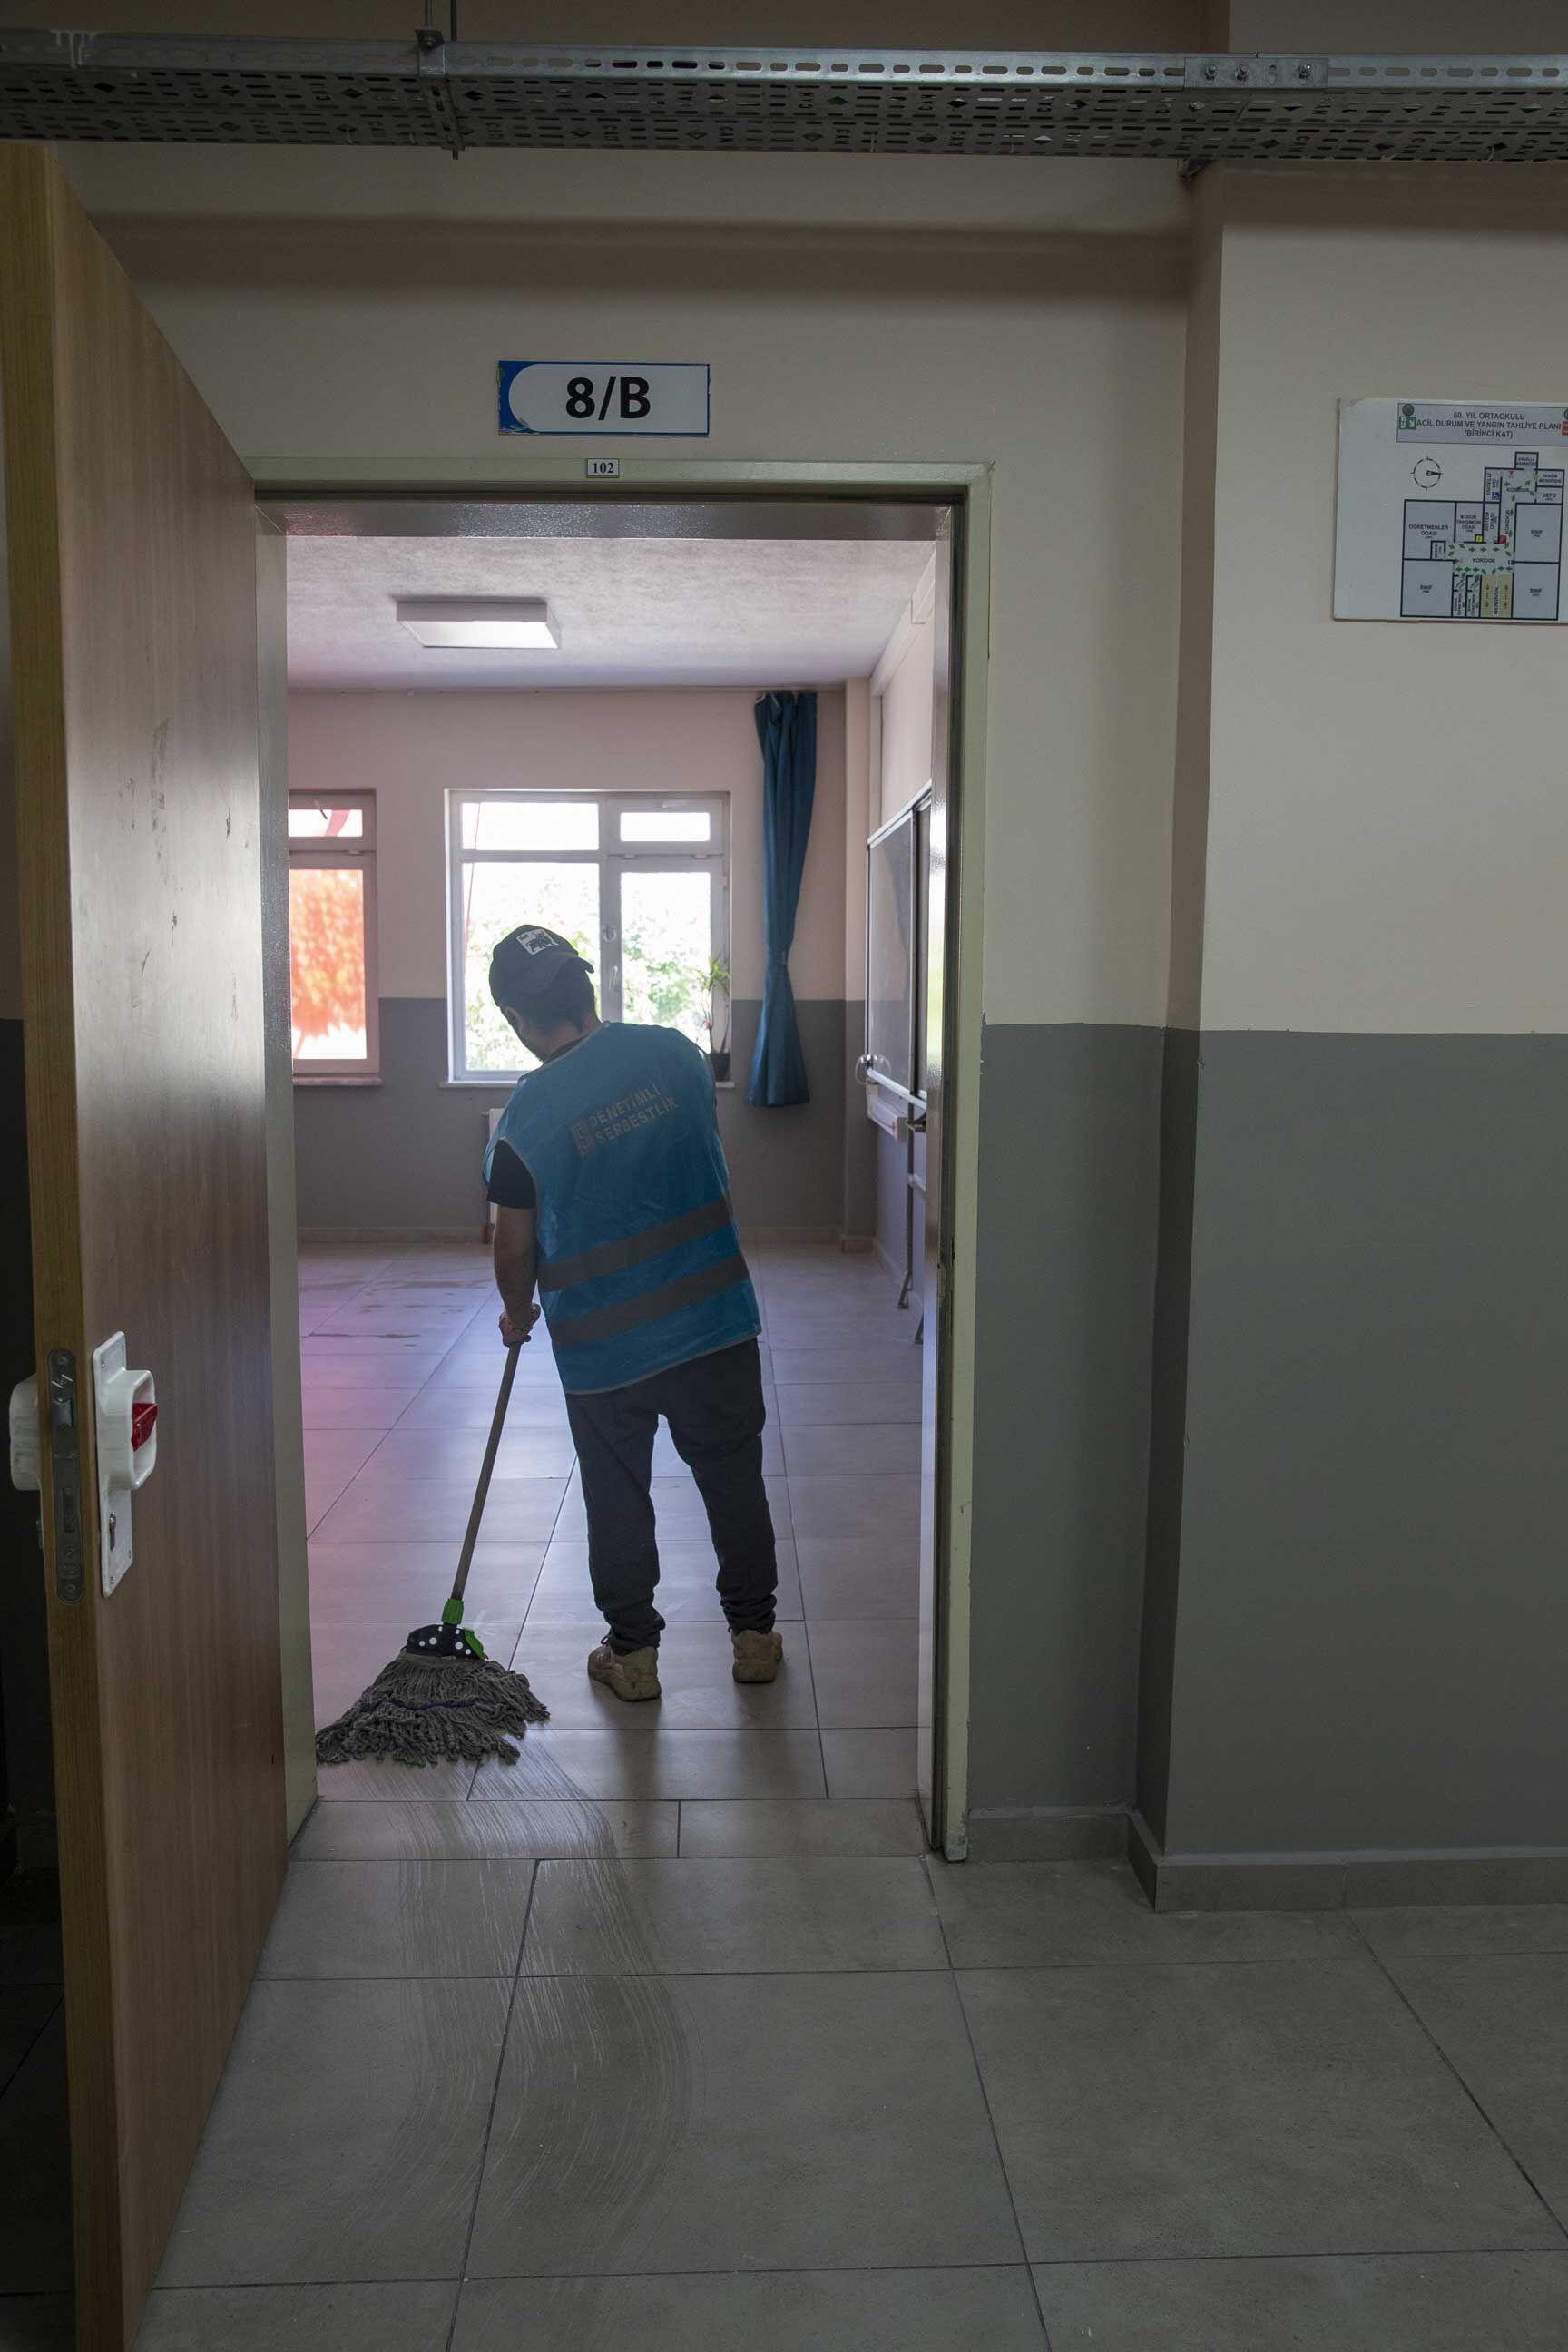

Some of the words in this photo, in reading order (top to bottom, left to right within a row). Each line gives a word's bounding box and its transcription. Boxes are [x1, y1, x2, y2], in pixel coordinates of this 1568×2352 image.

[566, 376, 651, 421] 8/B
[1465, 411, 1477, 419] YIL
[1479, 412, 1525, 420] ORTAOKULU
[1416, 418, 1434, 426] ACİL
[1436, 420, 1463, 428] DURUM
[1476, 421, 1504, 429] YANGIN
[1506, 420, 1537, 429] TAHLİYE
[1538, 422, 1562, 430] PLANI
[1464, 428, 1494, 437] (BİRİNCİ
[1495, 430, 1513, 439] KAT)
[593, 463, 613, 475] 102
